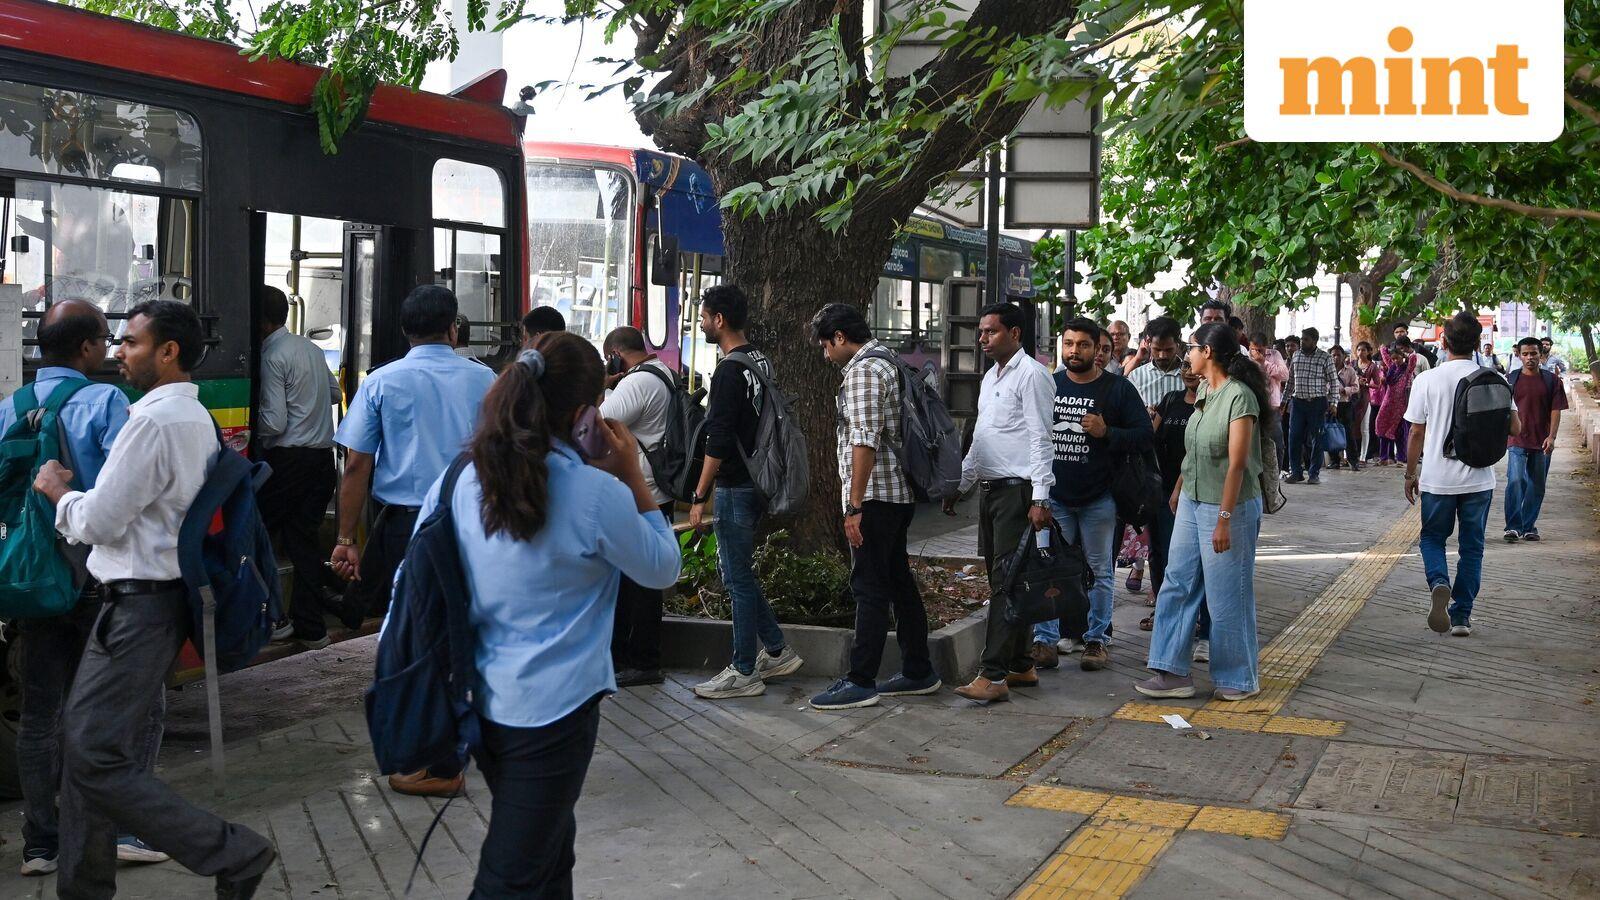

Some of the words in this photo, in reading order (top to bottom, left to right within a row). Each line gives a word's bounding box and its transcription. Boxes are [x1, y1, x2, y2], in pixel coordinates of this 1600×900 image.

[1054, 396, 1095, 408] AADATE
[1054, 406, 1087, 416] KHARAB
[1052, 432, 1086, 444] SHAUKH
[1053, 442, 1090, 454] AWABO
